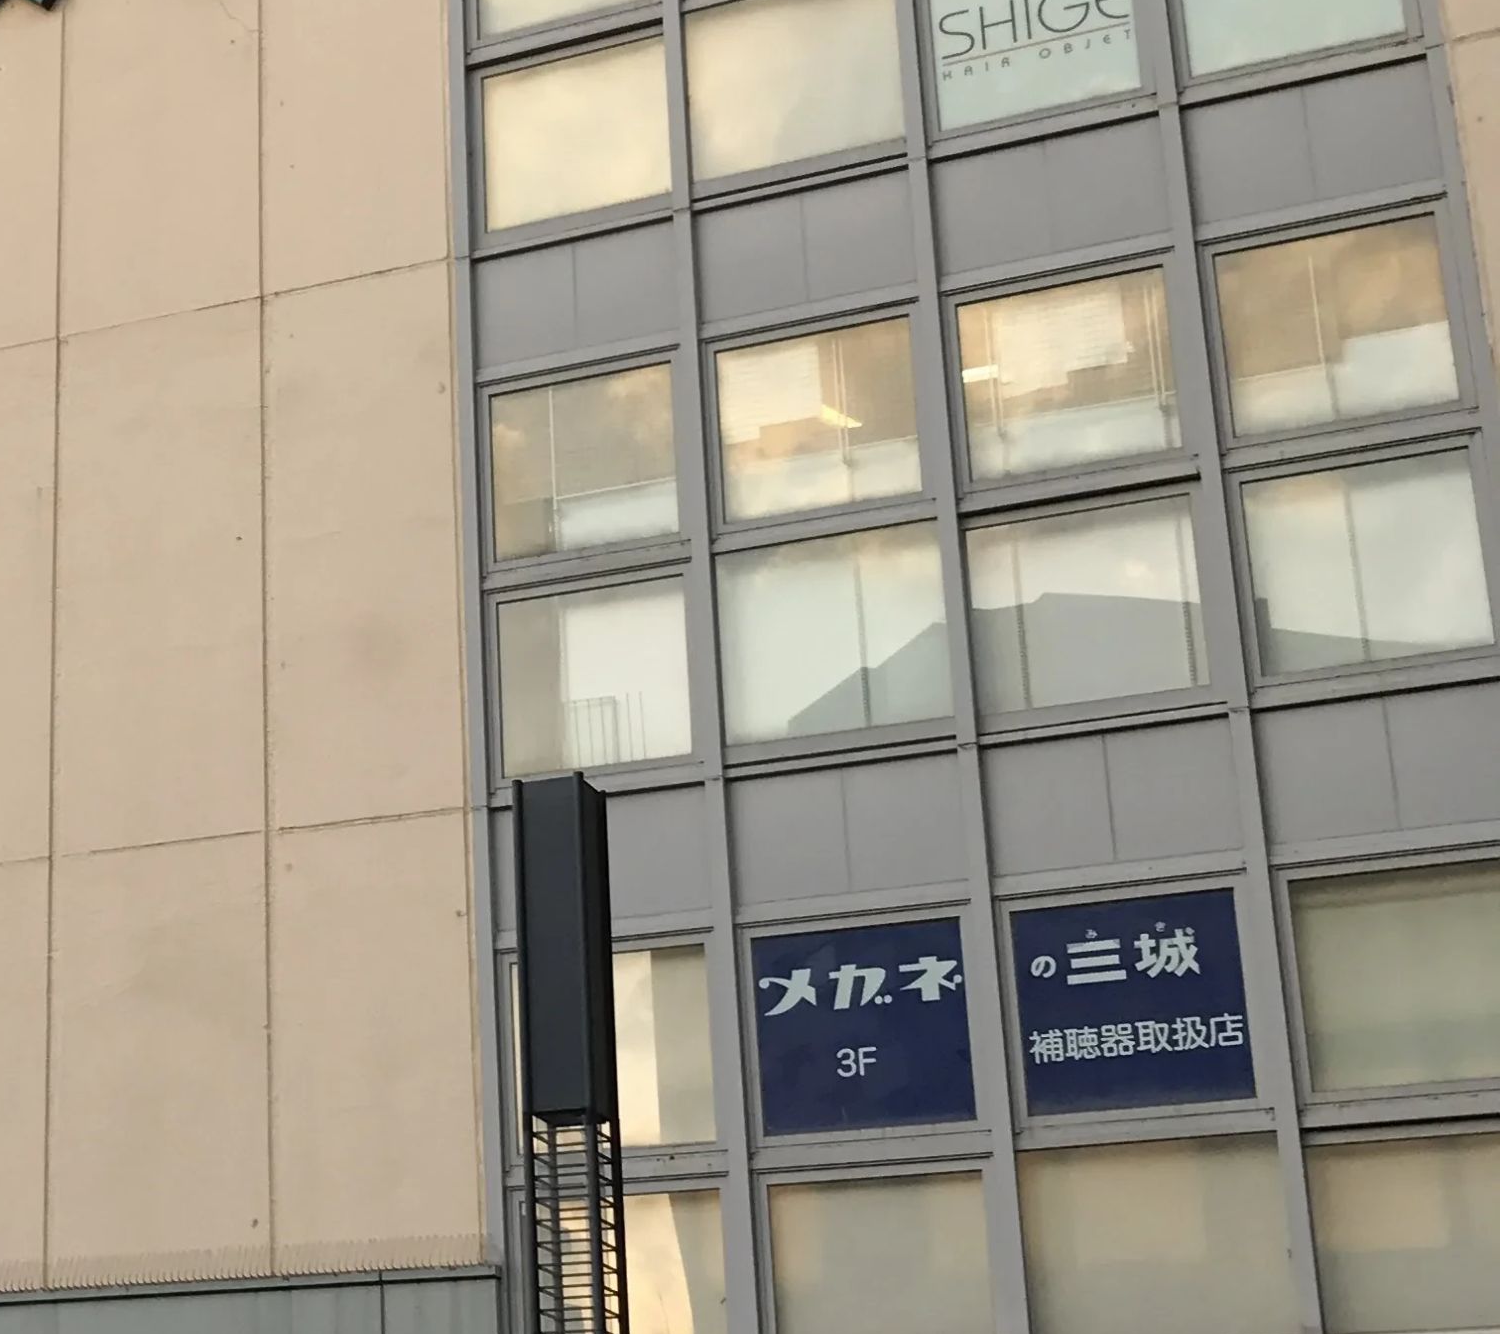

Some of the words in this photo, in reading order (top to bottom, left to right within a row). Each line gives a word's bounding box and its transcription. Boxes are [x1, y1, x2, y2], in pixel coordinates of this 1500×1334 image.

[758, 956, 963, 1016] メガネ
[836, 1047, 877, 1078] 3F
[1029, 1012, 1245, 1065] 補聴器取扱店
